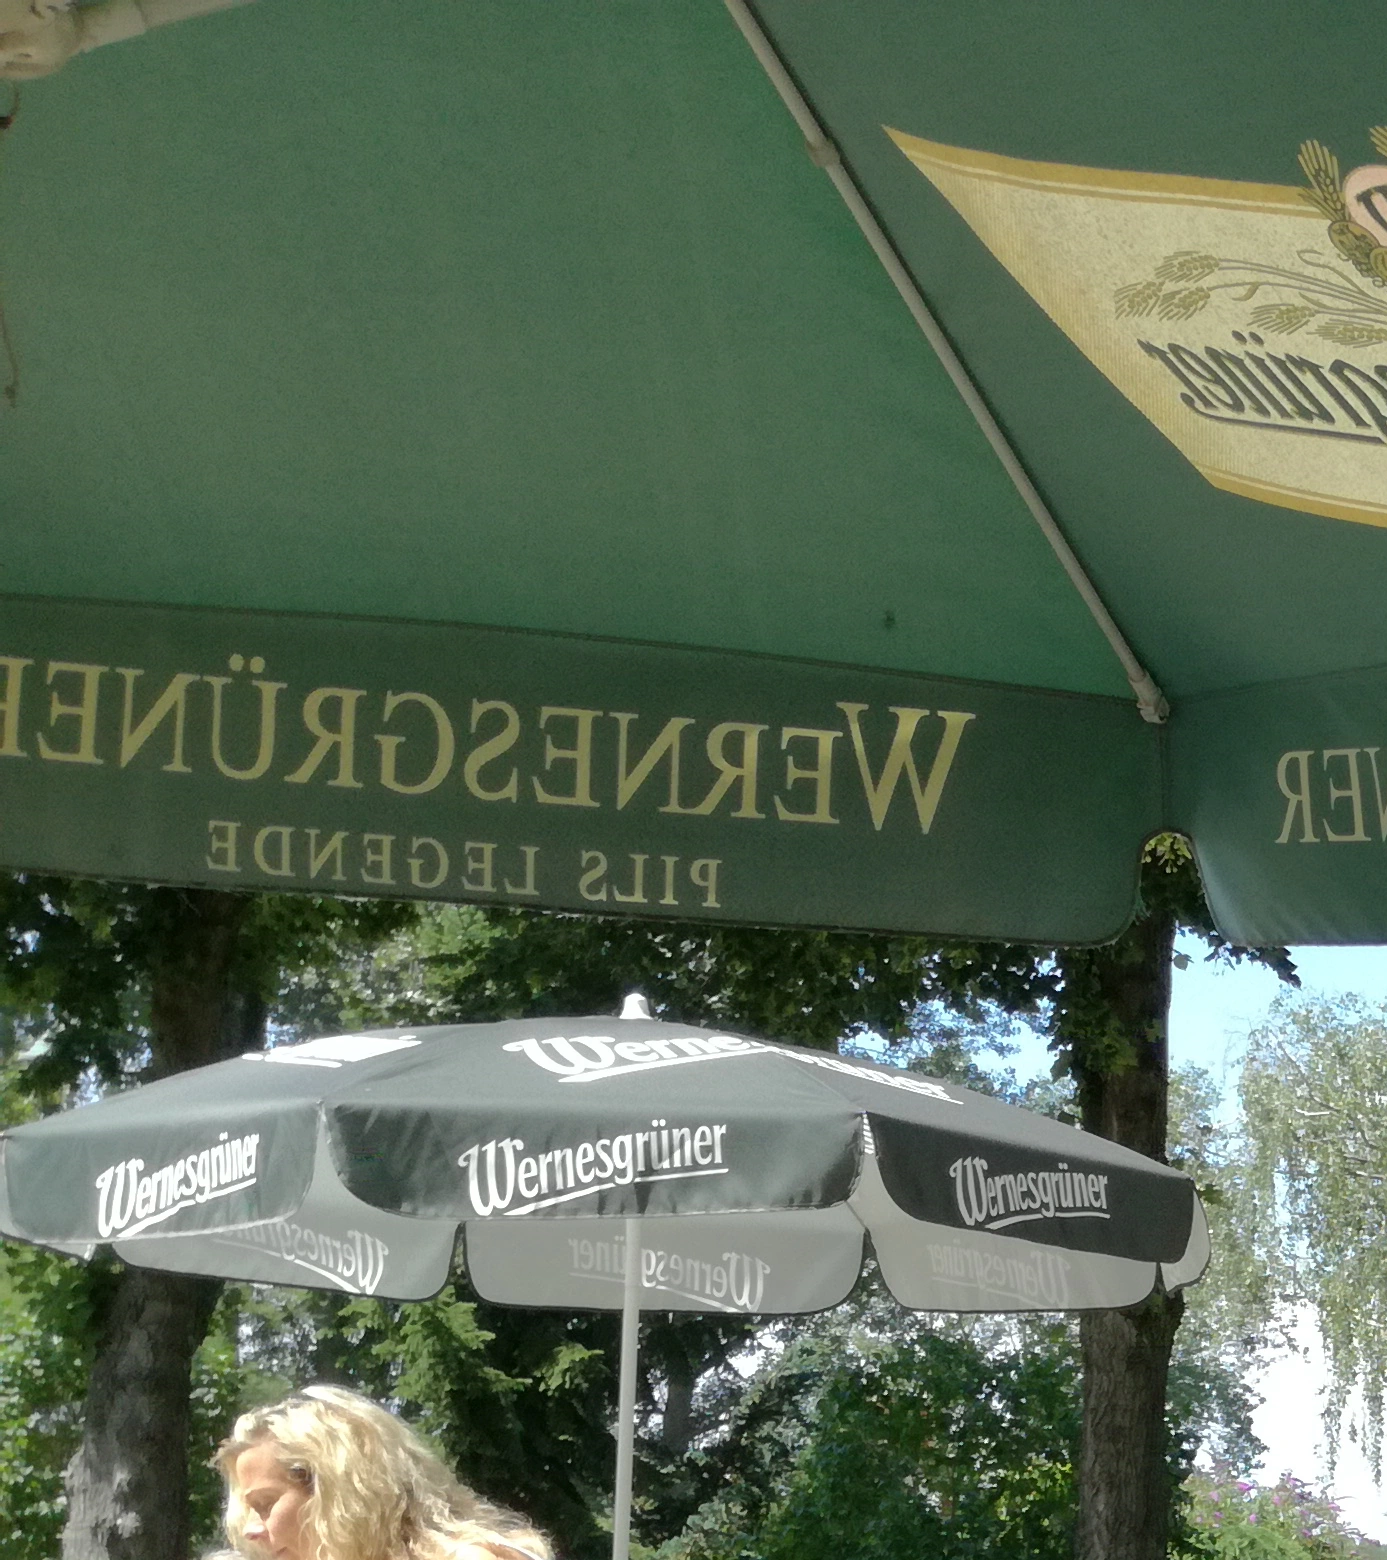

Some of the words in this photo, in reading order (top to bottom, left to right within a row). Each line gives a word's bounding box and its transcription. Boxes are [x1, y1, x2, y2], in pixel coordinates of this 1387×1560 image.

[96, 1131, 260, 1238] Wernesgrüner
[458, 1119, 728, 1217] Wernesgrüner
[949, 1156, 1109, 1228] Wernesgrüner
